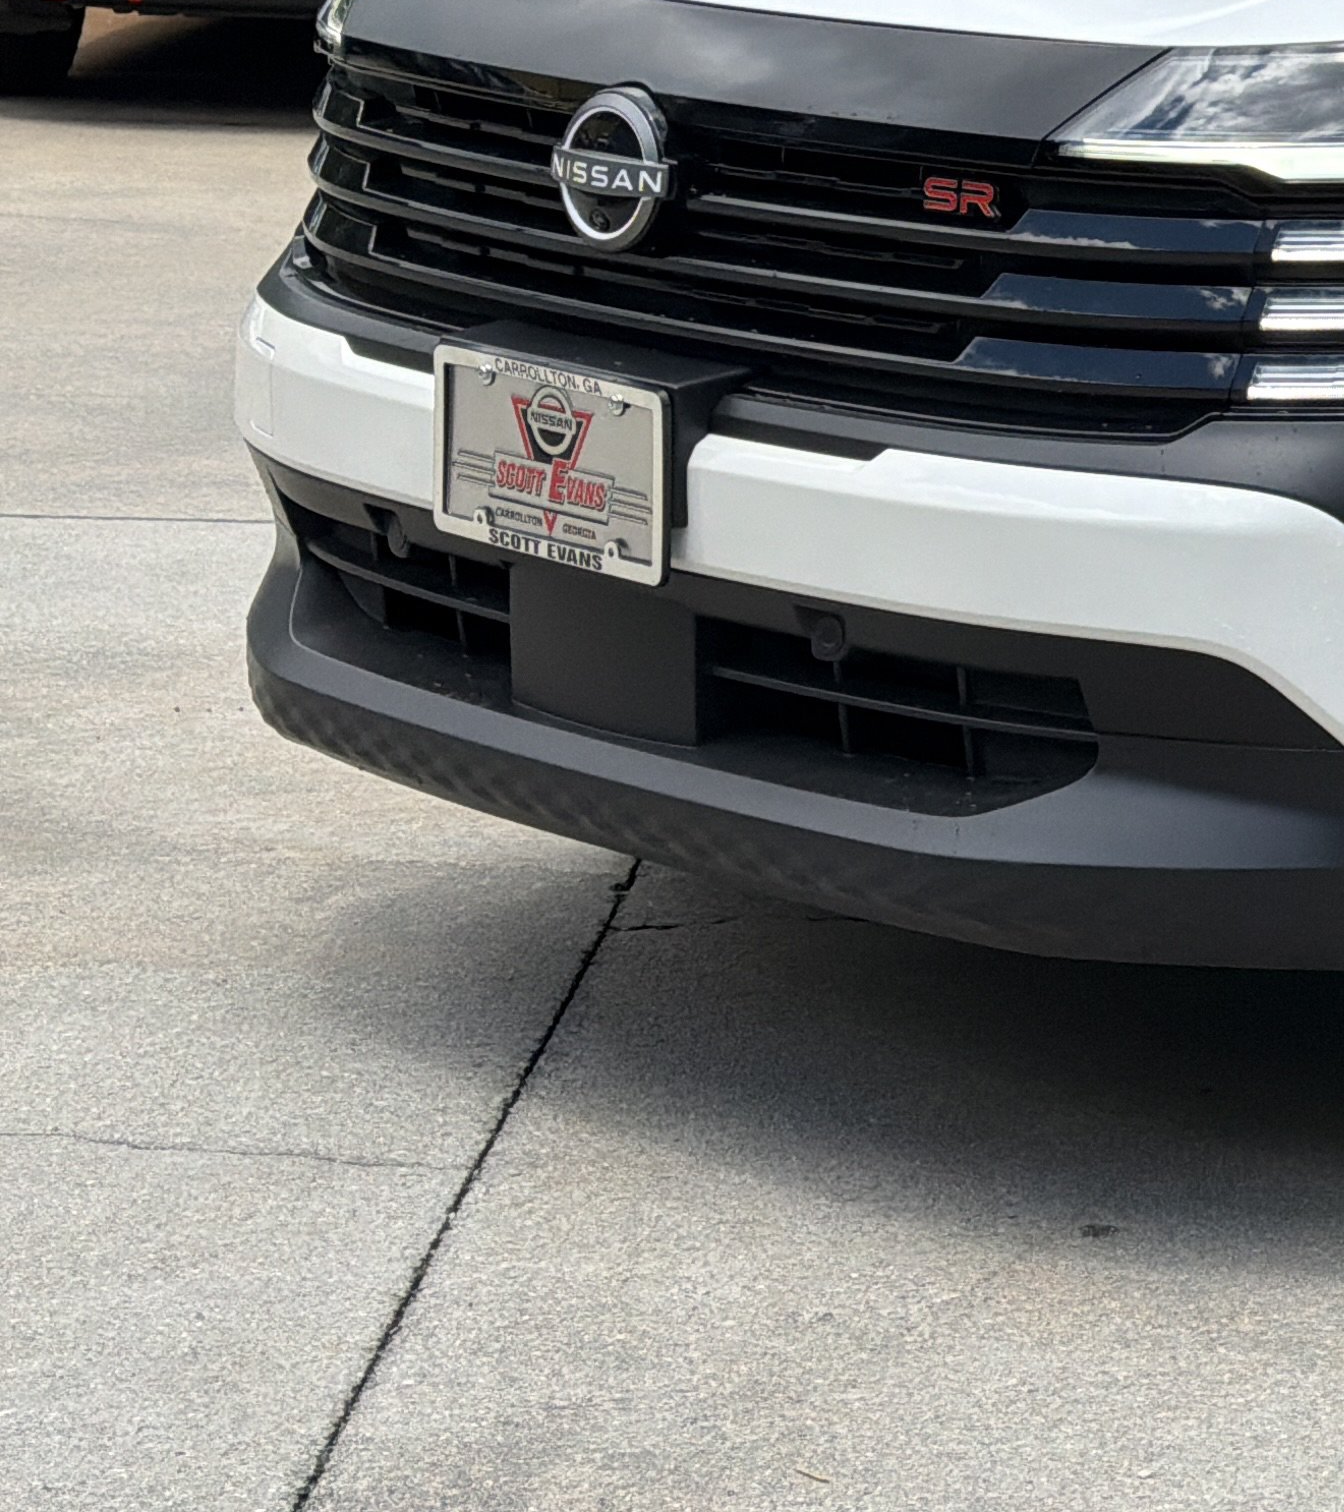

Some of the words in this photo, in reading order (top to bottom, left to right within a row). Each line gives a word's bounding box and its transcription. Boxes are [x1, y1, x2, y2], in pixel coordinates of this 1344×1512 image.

[551, 151, 663, 193] NISSAN
[922, 176, 1000, 218] SR
[495, 357, 580, 391] CARROLLTON,
[582, 378, 602, 395] GA
[530, 411, 574, 432] NISSAN
[496, 460, 546, 497] SCOTT
[548, 460, 608, 510] EVANS
[495, 508, 543, 527] CARROLLTON
[562, 523, 597, 540] GEORGIA
[489, 528, 540, 555] SCOTT
[547, 544, 602, 571] EVANS
